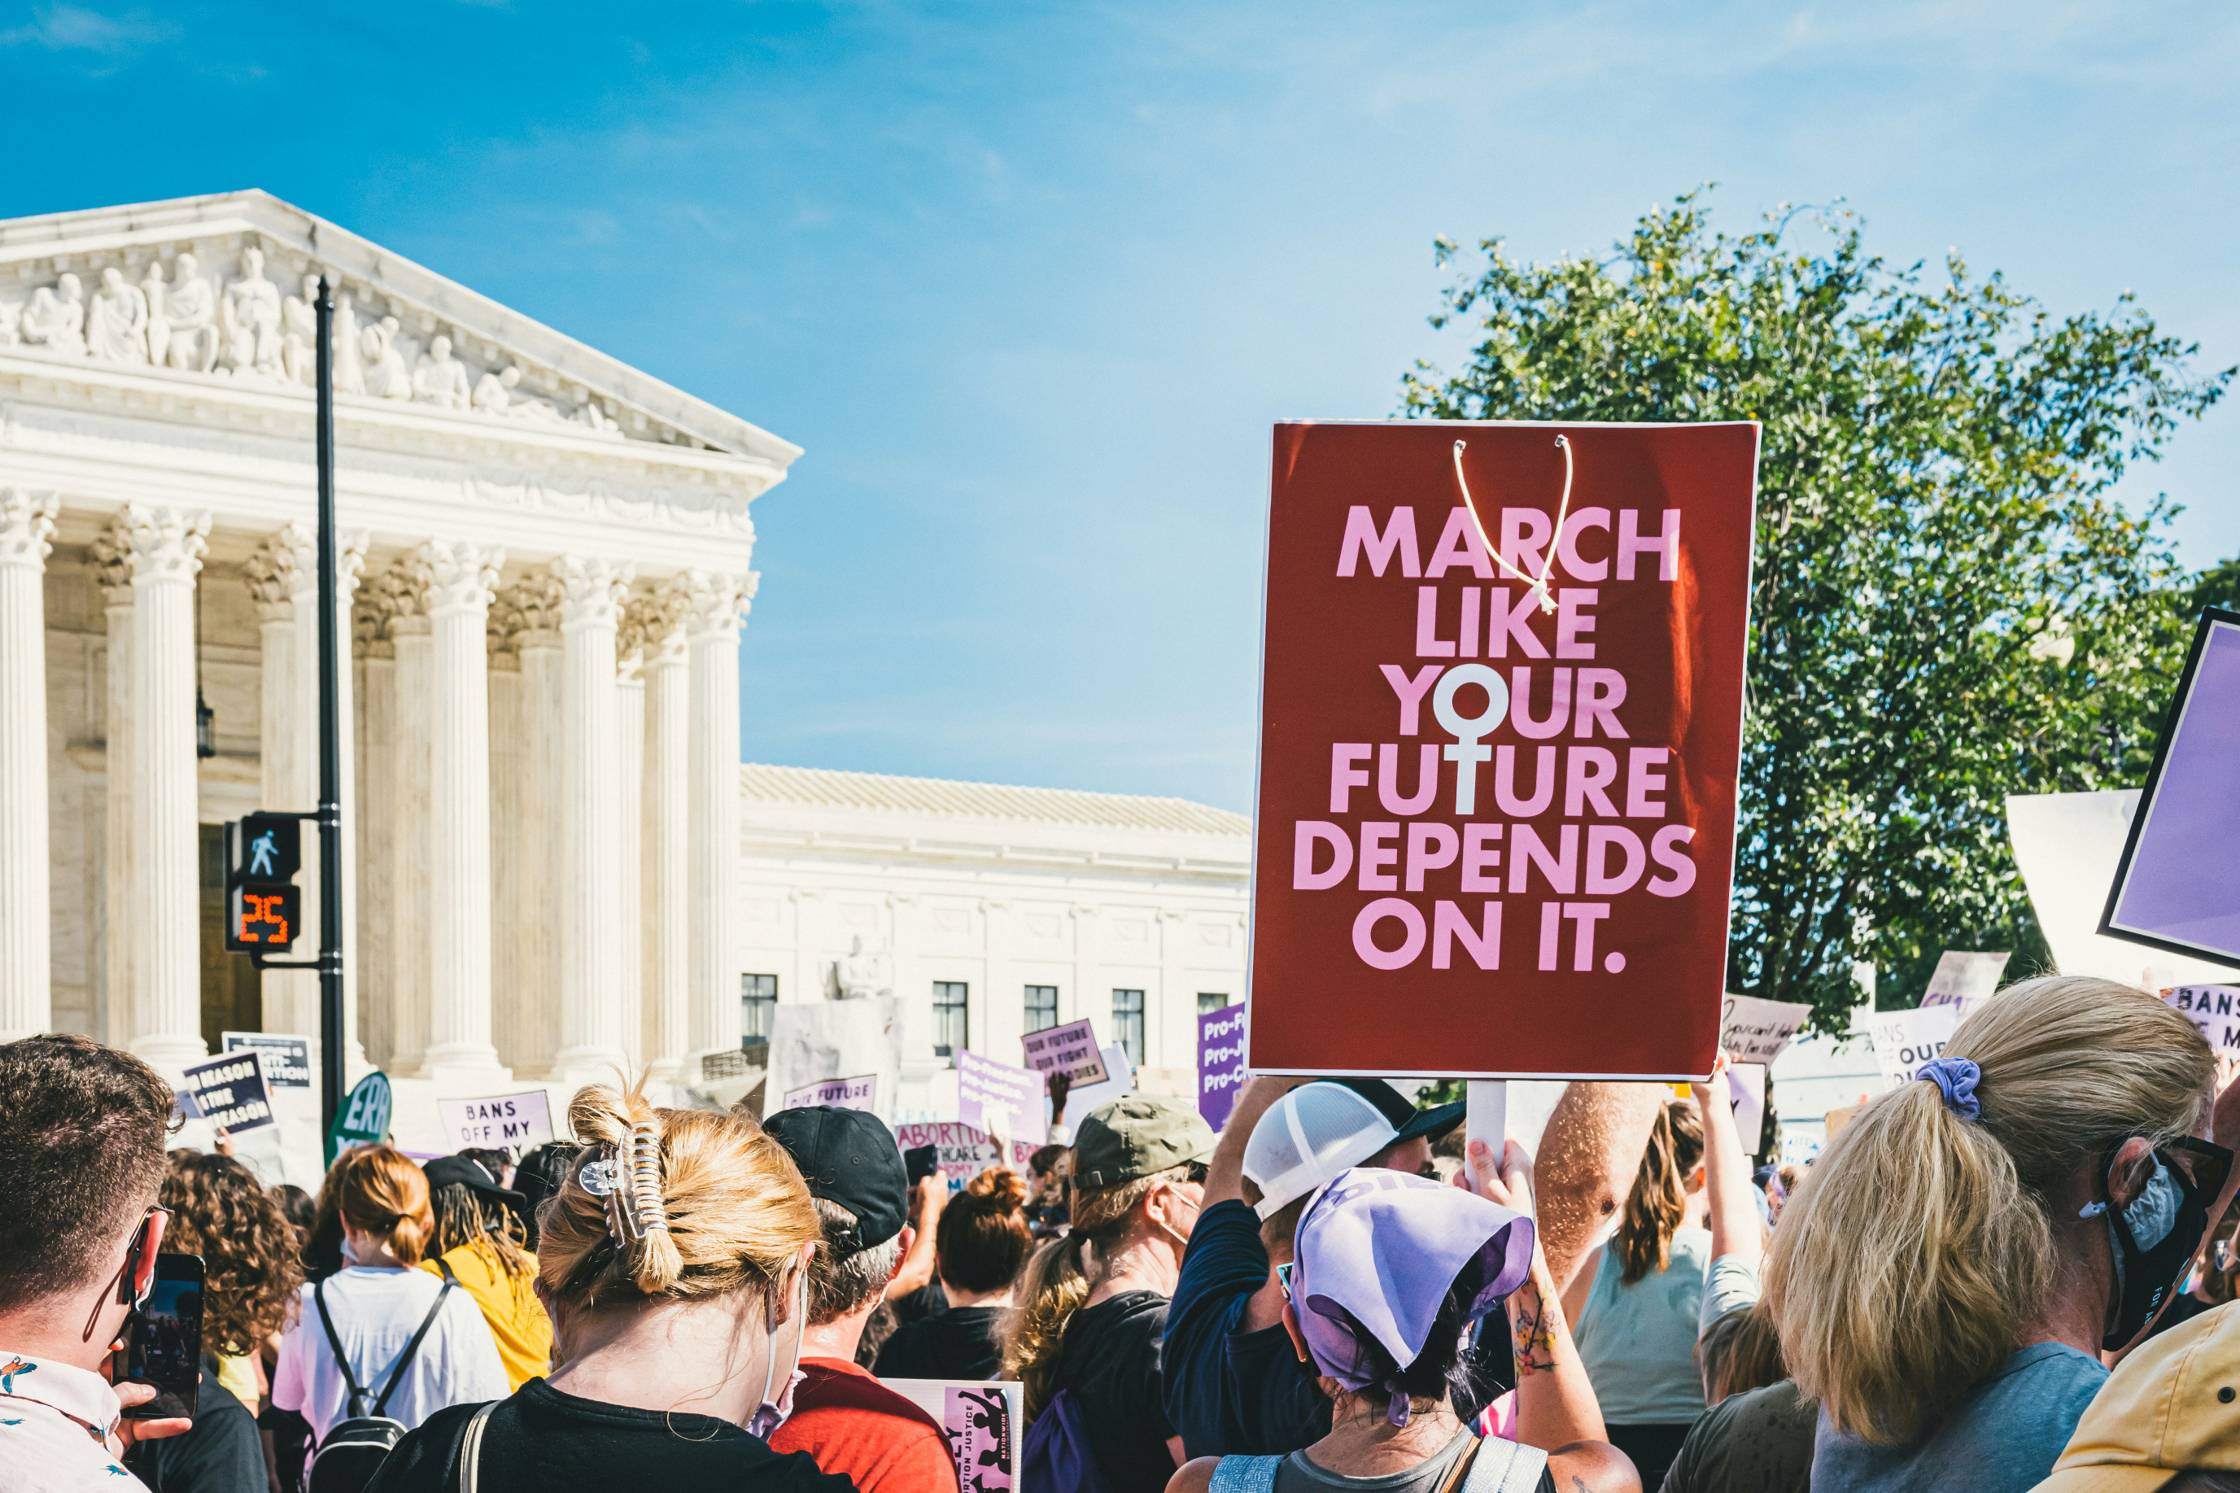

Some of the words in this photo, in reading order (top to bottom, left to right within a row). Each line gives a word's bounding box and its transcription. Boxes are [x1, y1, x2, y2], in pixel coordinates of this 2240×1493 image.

[1337, 506, 1681, 581] MARCH
[1416, 586, 1599, 659] LIKE
[1380, 664, 1630, 741] YOUR
[1330, 743, 1669, 817] FUTURE
[1294, 820, 1697, 897] DEPENDS
[239, 894, 288, 943] 25
[1353, 898, 1503, 971] ON
[1539, 902, 1626, 974] IT.
[1204, 1012, 1244, 1041] Pro-F
[1204, 1038, 1243, 1067] Pro-J
[818, 1084, 869, 1102] FUTURE
[1204, 1064, 1247, 1094] Pro-C
[461, 1126, 492, 1142] OFF
[503, 1121, 530, 1139] MY
[466, 1101, 516, 1120] BANS
[897, 1122, 988, 1147] ABORTIO
[965, 1404, 973, 1452] JUSTICE
